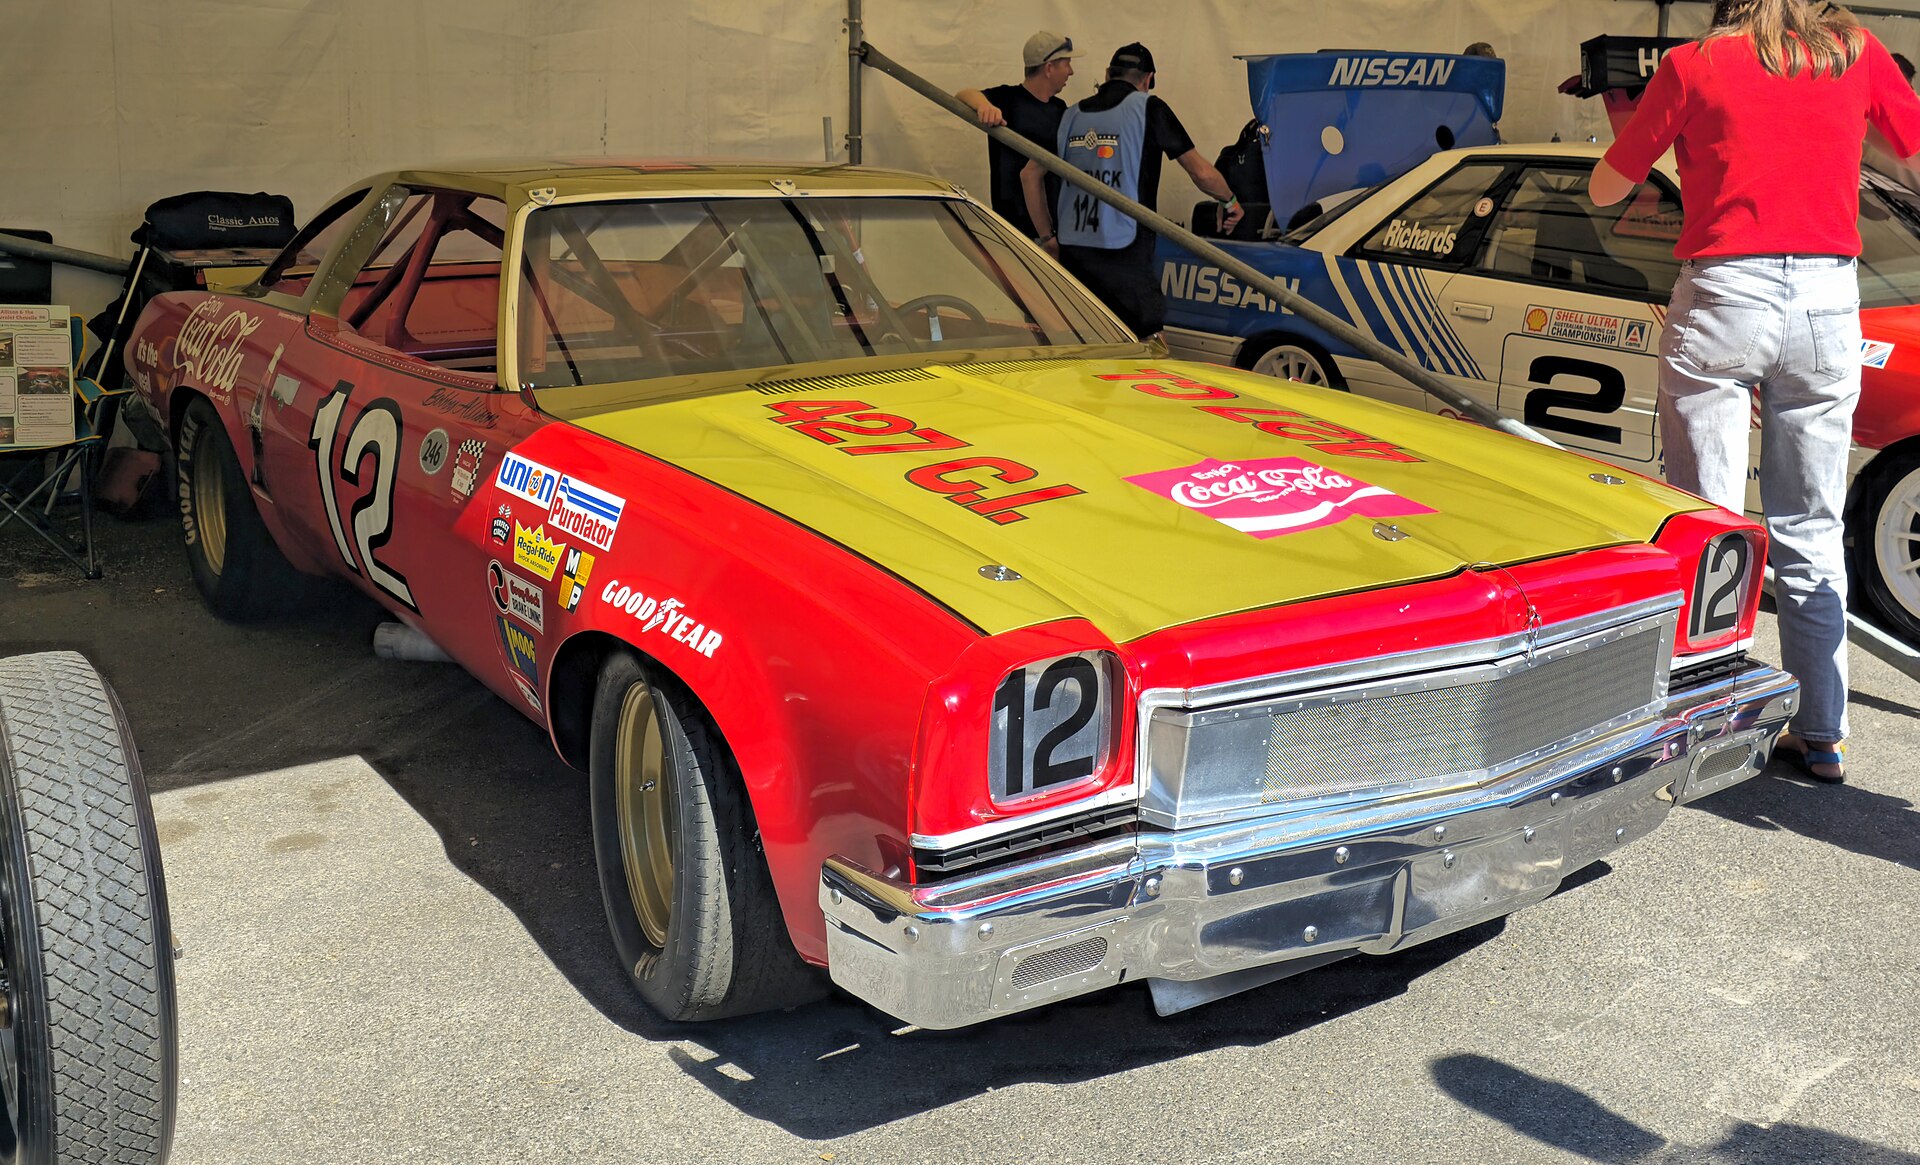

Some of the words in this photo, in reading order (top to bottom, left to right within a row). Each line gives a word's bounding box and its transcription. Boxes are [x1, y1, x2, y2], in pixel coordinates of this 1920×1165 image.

[1328, 57, 1455, 86] NISSAN
[207, 214, 244, 226] Classic
[248, 215, 280, 225] Autos
[1074, 194, 1099, 232] 114
[1478, 202, 1488, 213] E
[1382, 219, 1457, 255] Richards
[203, 296, 225, 318] Enjoy
[1555, 311, 1584, 324] SHELL
[1587, 314, 1618, 329] ULTRA
[1551, 327, 1617, 345] CHAMPIONSHIP
[1553, 321, 1583, 330] AUSTRALIAN
[1524, 355, 1626, 443] 2
[762, 400, 974, 456] 427
[1192, 406, 1426, 463] 427
[421, 438, 443, 467] 246
[529, 477, 540, 490] 76
[1190, 463, 1241, 481] Enjoy
[308, 379, 424, 618] 12
[492, 528, 507, 540] CIRCLE
[493, 519, 510, 532] PERFECT
[549, 496, 614, 548] Purolator
[517, 553, 530, 564] SHOCK
[565, 548, 580, 574] M
[566, 584, 582, 610] P
[1689, 532, 1748, 638] 12
[511, 597, 528, 618] BRAKE
[601, 580, 723, 659] GOODYEAR
[510, 626, 536, 664] MOOG
[994, 656, 1099, 796] 12
